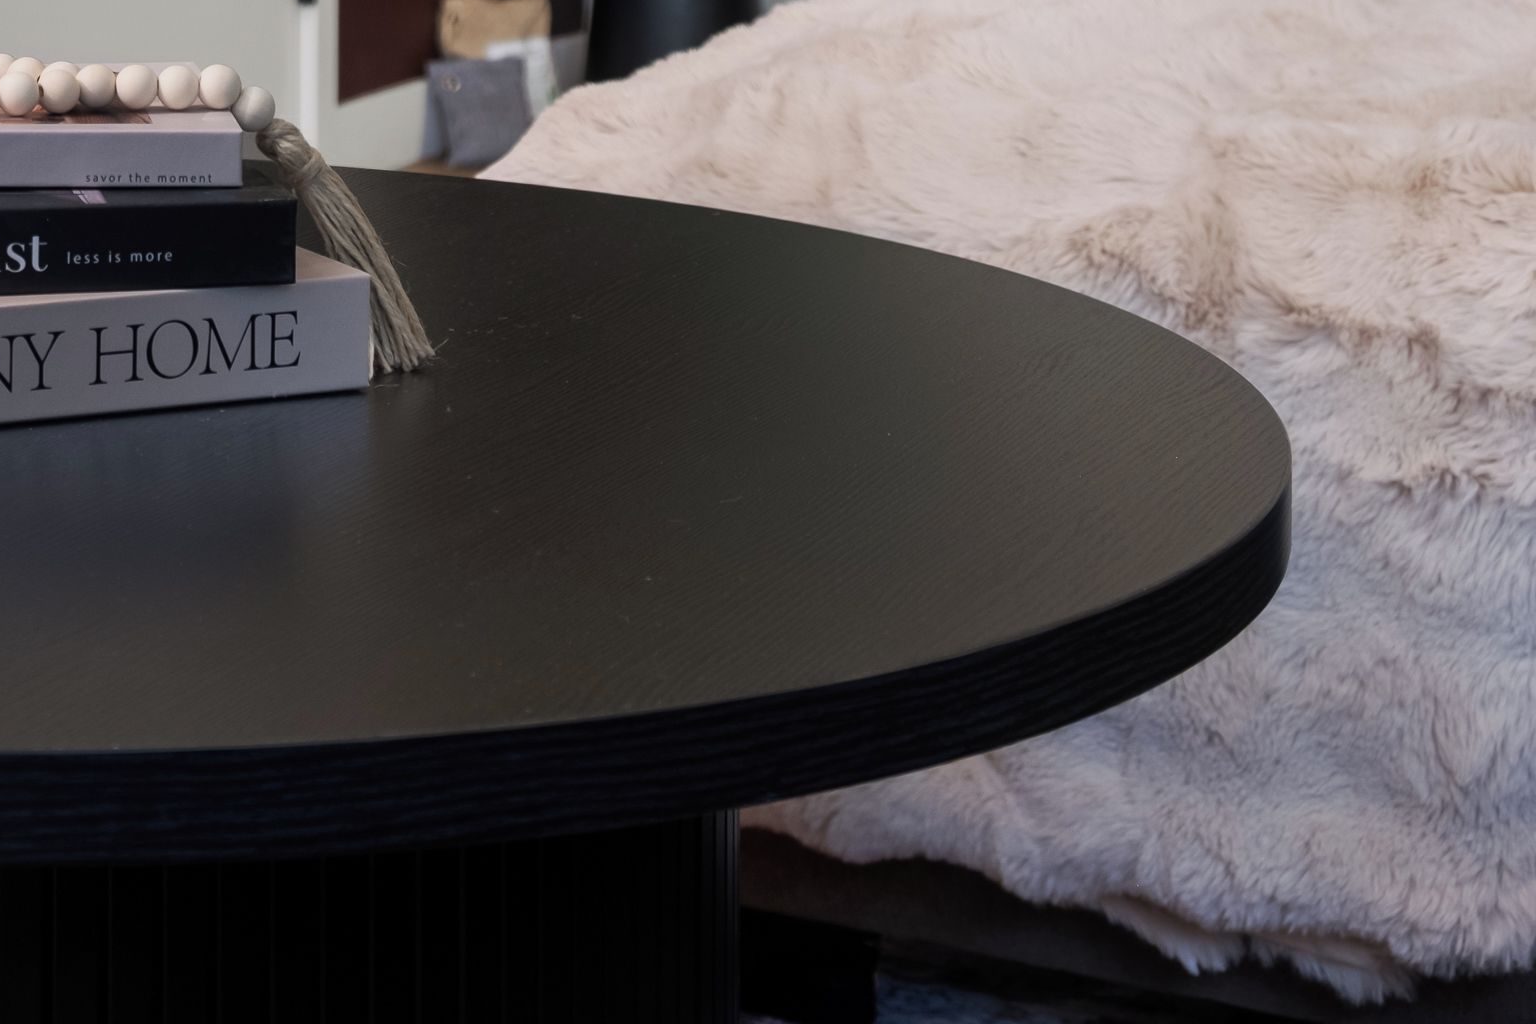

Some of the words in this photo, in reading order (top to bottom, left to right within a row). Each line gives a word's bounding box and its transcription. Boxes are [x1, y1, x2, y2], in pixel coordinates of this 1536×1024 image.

[85, 173, 122, 184] savor
[129, 172, 151, 183] the
[157, 173, 213, 184] moment
[66, 250, 100, 265] less
[107, 249, 122, 264] is
[129, 249, 174, 263] more
[89, 310, 301, 386] HOME
